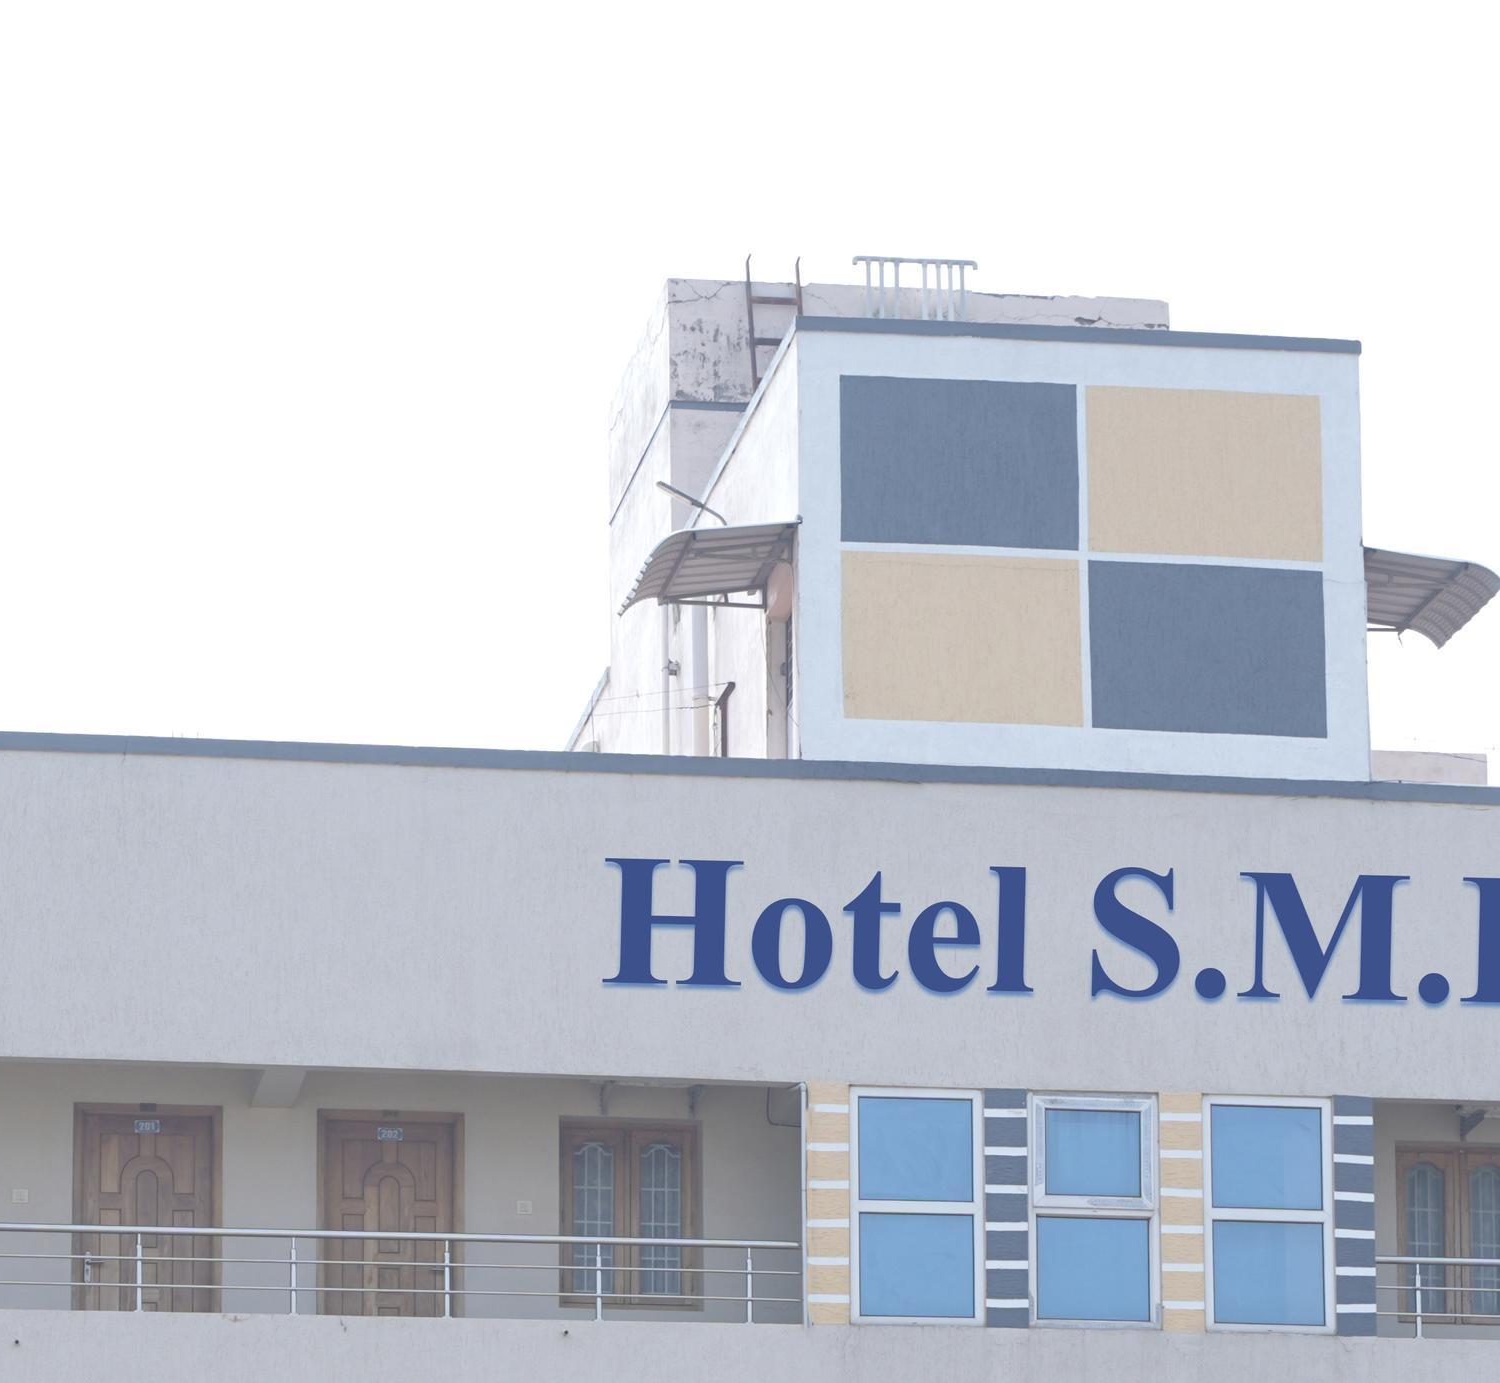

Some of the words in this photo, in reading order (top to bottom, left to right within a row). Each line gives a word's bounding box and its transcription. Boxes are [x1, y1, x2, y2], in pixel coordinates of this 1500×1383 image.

[602, 857, 1034, 995] Hotel
[138, 1121, 156, 1131] 201
[380, 1129, 399, 1139] 202
